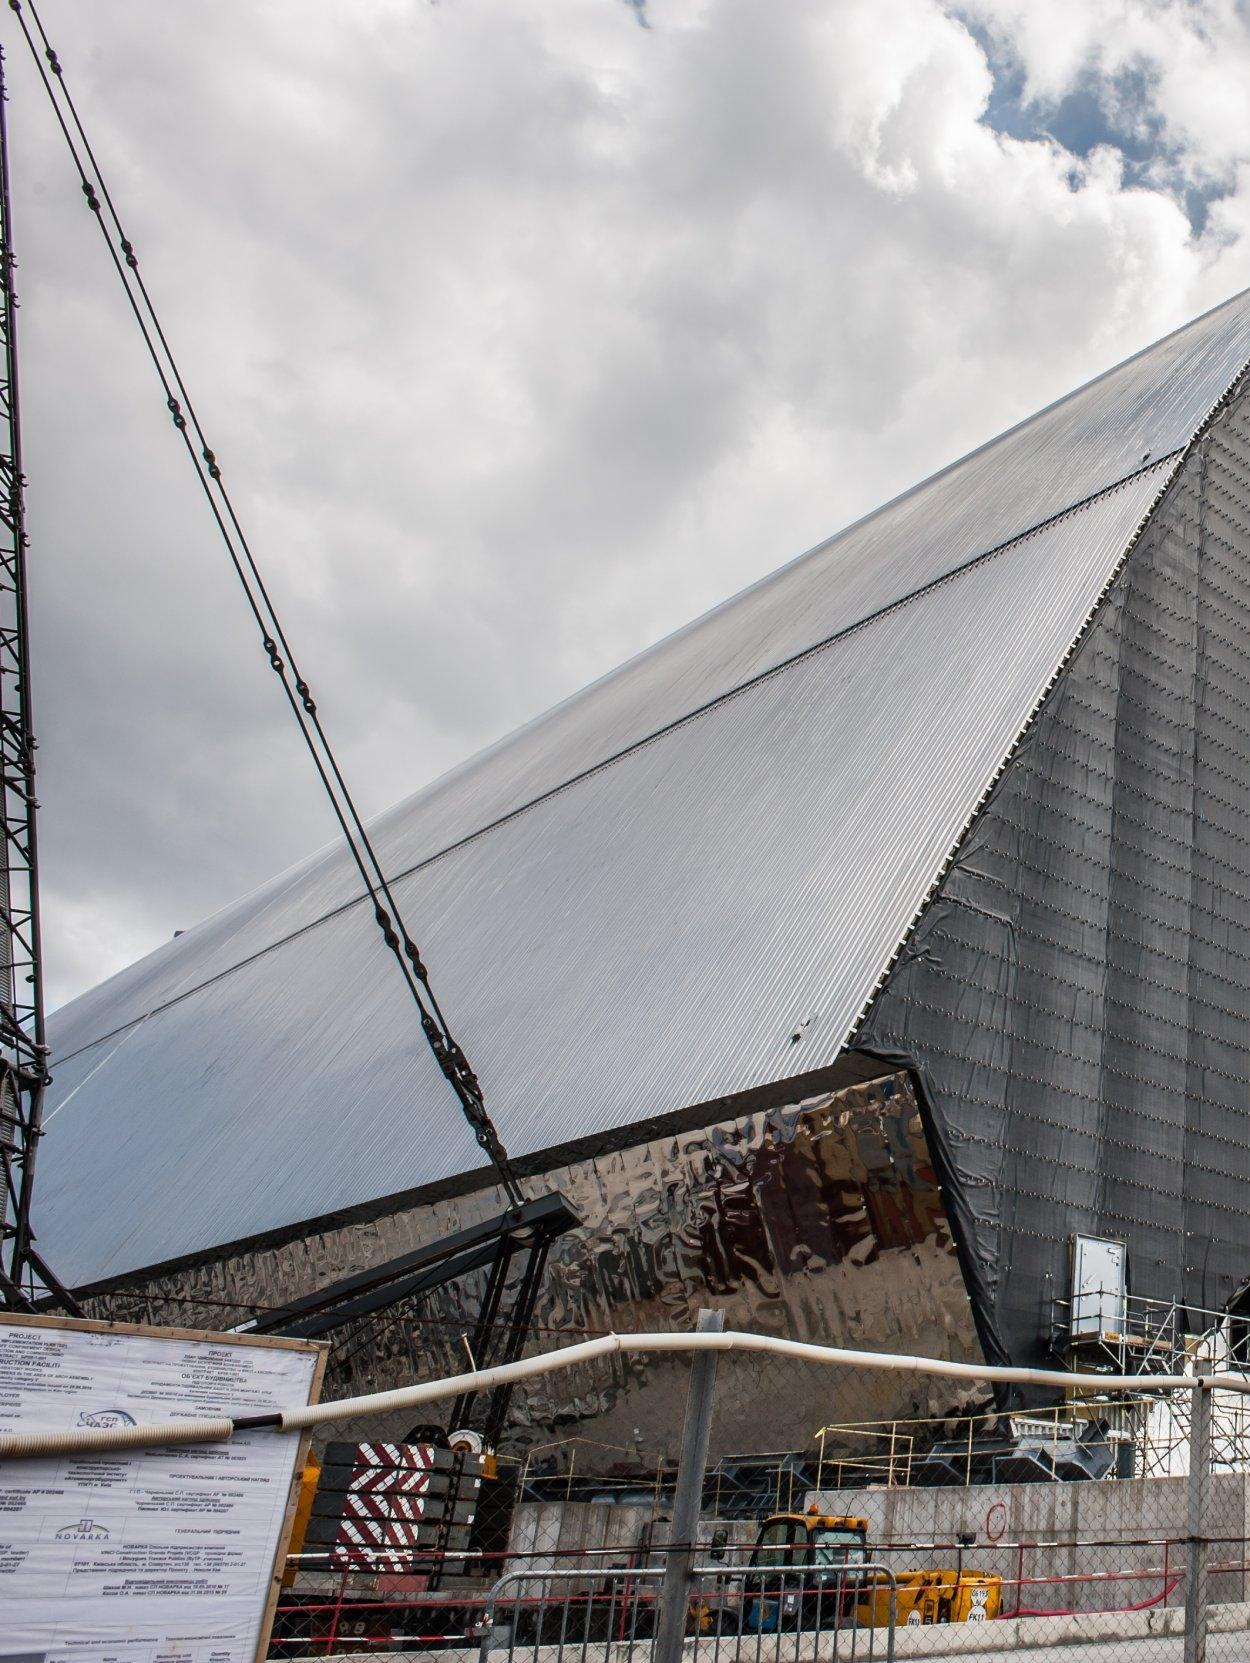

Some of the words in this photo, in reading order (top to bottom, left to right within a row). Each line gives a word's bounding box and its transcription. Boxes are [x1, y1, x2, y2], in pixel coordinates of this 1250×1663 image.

[209, 1350, 233, 1358] ПРОЕКТ
[55, 1533, 110, 1541] NOVARKA
[128, 1637, 159, 1645] performance
